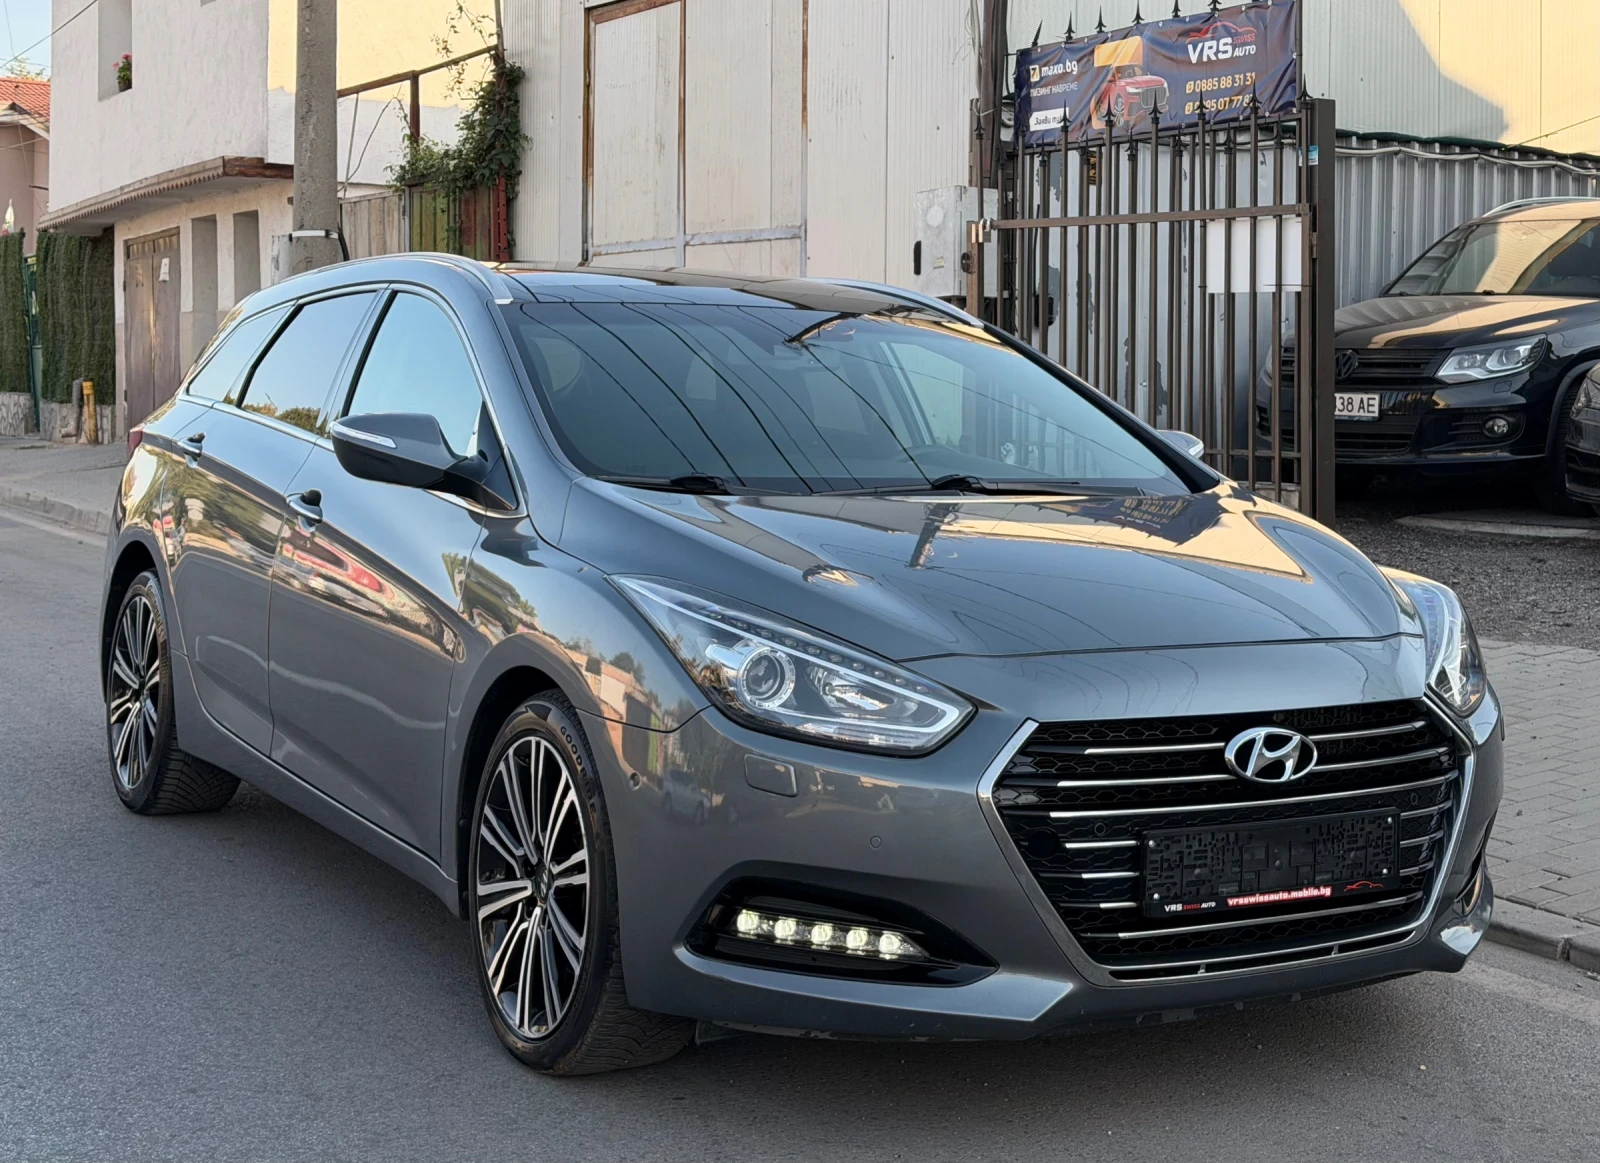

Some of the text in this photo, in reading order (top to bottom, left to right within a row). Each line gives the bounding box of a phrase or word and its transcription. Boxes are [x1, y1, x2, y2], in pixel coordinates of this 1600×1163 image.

[1233, 33, 1256, 44] SWISS
[1187, 37, 1257, 64] VRS AUTO
[1041, 59, 1078, 77] maxo.bg
[1195, 77, 1219, 93] 0885
[1220, 75, 1233, 89] 88
[1234, 73, 1244, 87] 31
[1194, 98, 1217, 114] 095
[1218, 97, 1230, 111] 07
[1230, 95, 1243, 109] 77
[1335, 396, 1377, 414] 38 AE
[560, 726, 597, 813] GOODRIDE
[1227, 886, 1331, 906] vrsswissauto.mobile.bg
[1164, 904, 1183, 913] VRS
[1201, 901, 1216, 909] AUTO
